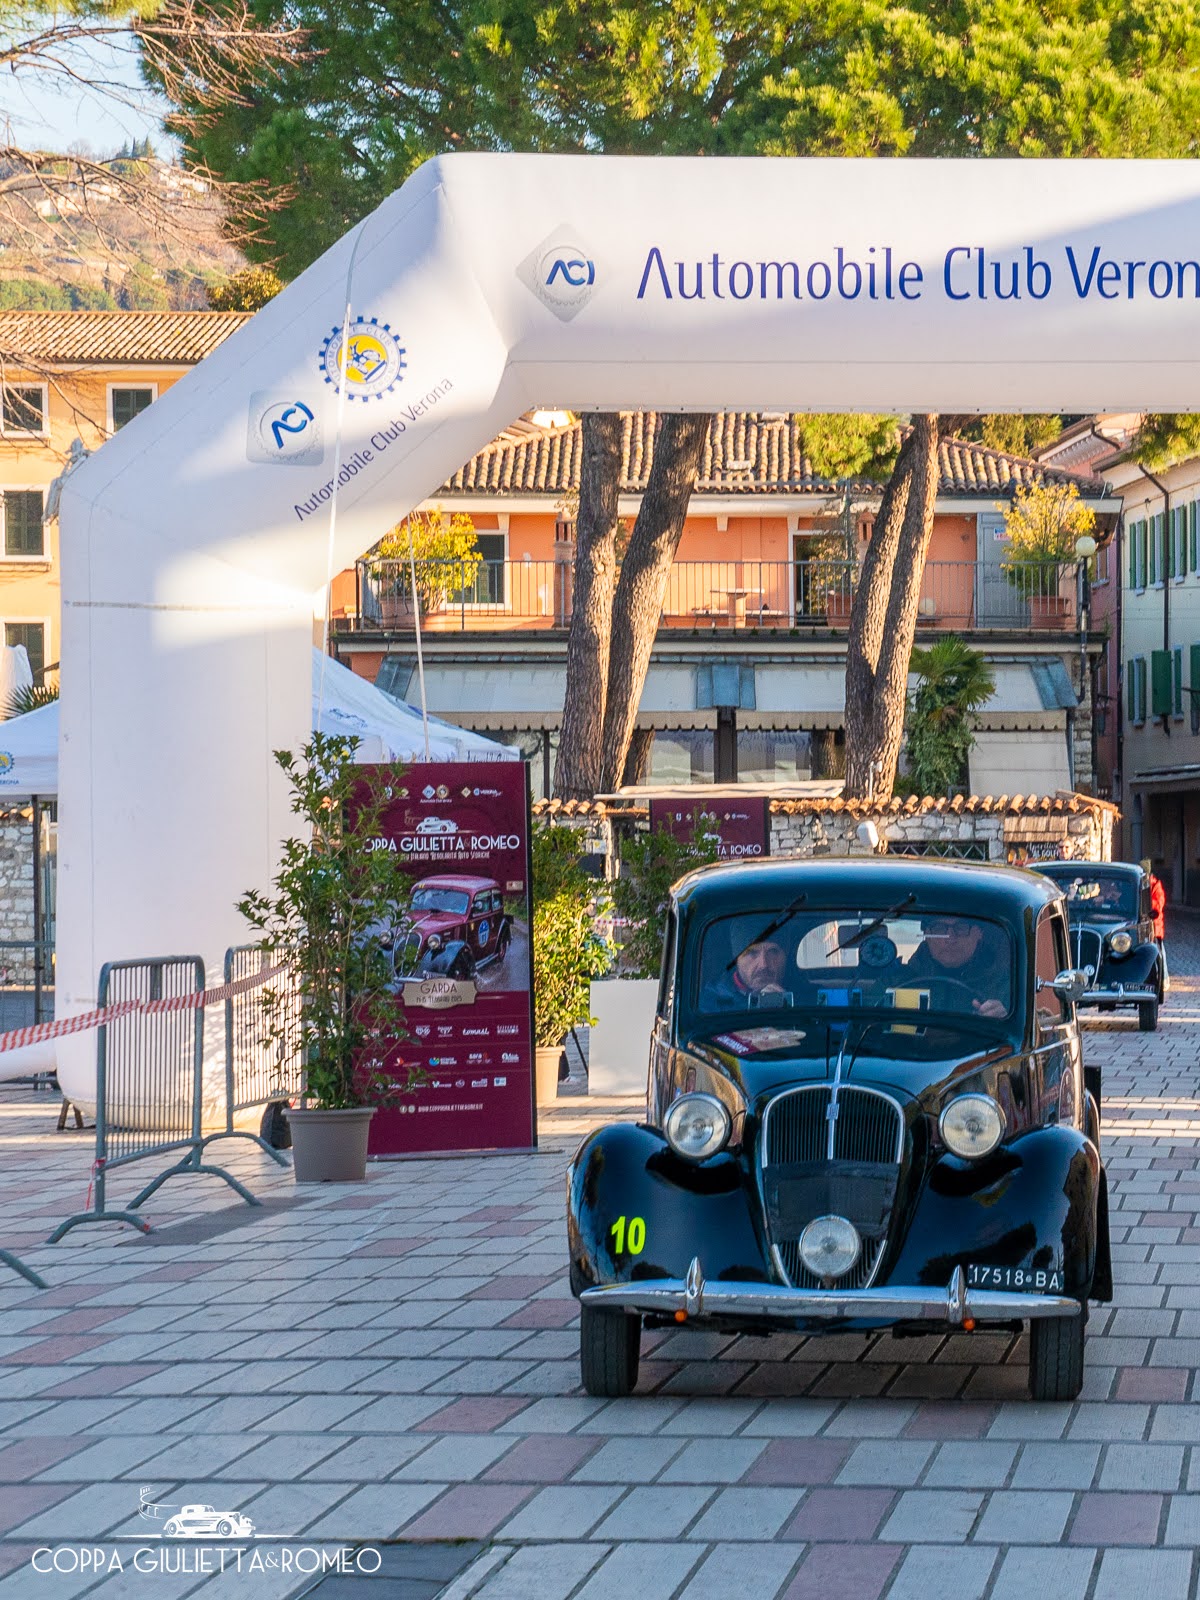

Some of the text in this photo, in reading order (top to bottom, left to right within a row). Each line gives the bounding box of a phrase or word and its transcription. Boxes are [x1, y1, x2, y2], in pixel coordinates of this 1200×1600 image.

[637, 246, 924, 300] Automobile
[944, 246, 1051, 300] Club
[293, 377, 454, 521] Automobile Club Verona
[355, 837, 397, 854] OPPA
[400, 835, 465, 852] GIULIETTA
[471, 834, 520, 851] ROMEO
[730, 844, 762, 855] ROMEO
[420, 982, 458, 995] GARDA
[611, 1215, 646, 1256] 10
[973, 1266, 1060, 1290] 17518 BA
